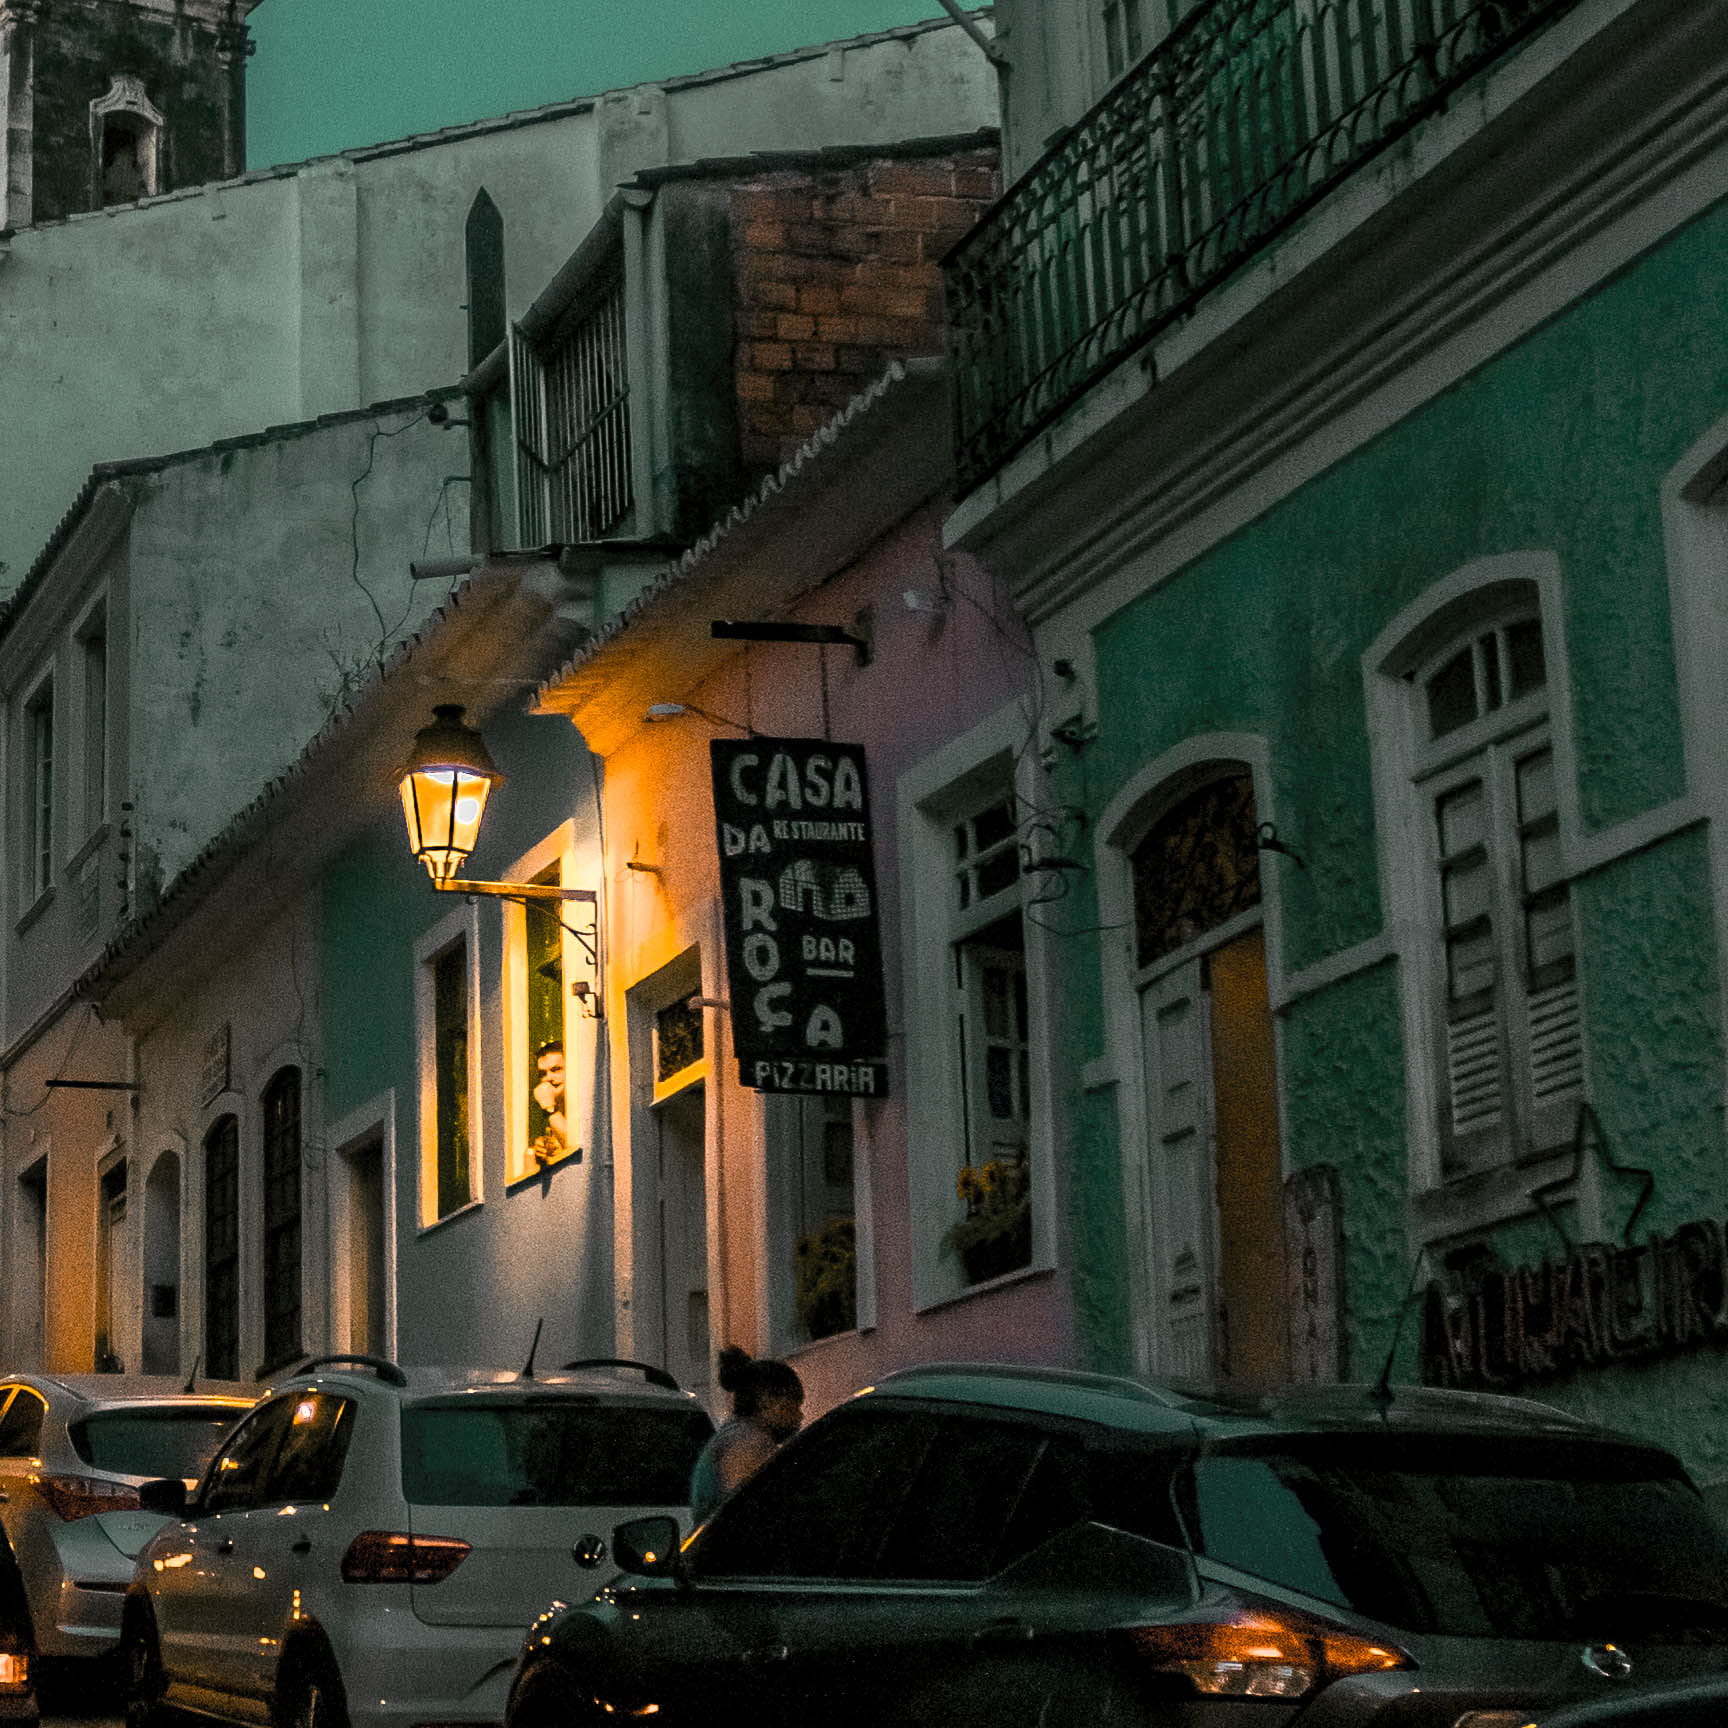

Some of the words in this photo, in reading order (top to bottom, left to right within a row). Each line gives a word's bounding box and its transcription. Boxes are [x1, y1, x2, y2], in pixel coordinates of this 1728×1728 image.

[729, 753, 863, 811] CASA
[723, 822, 771, 855] DA
[773, 819, 866, 842] RESTAURANTE
[802, 935, 856, 965] BAR
